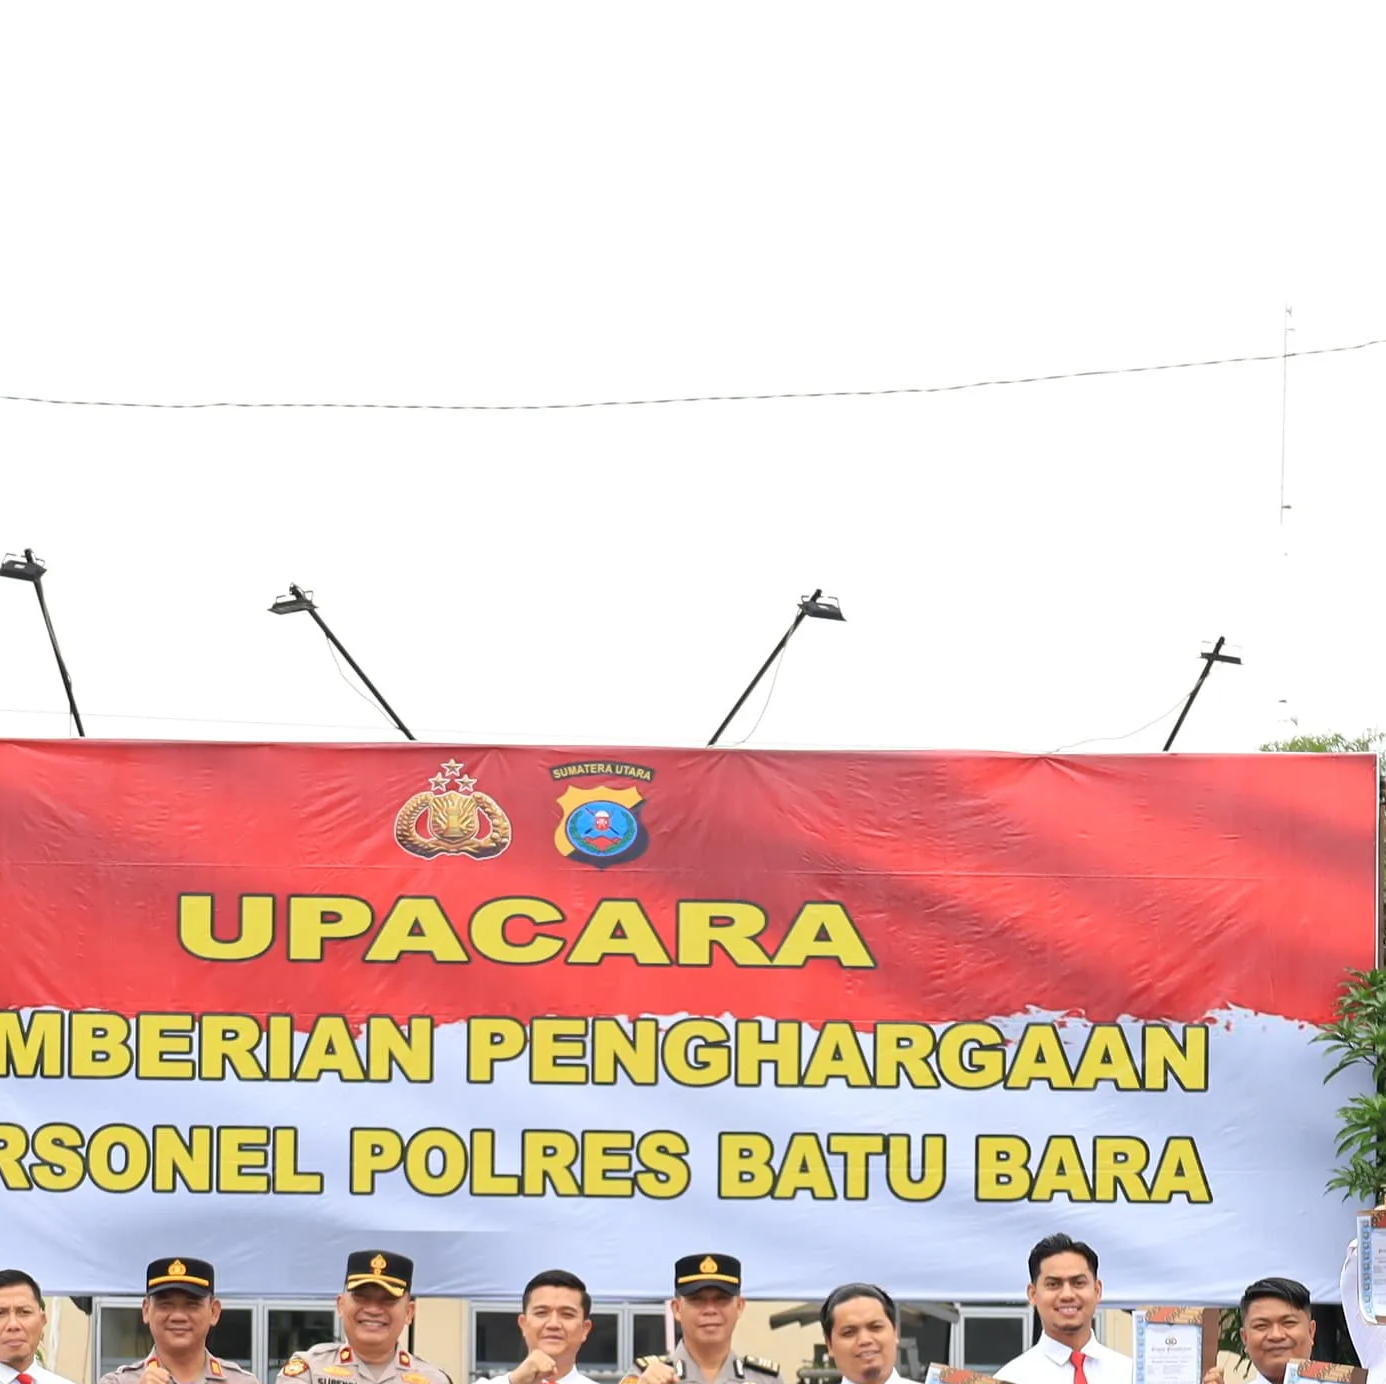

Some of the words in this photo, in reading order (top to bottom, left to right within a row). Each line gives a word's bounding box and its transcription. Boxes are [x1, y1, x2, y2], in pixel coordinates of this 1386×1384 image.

[553, 763, 613, 779] SUMATERA
[616, 765, 651, 780] UTARA
[176, 892, 878, 971] UPACARA
[466, 1014, 1210, 1093] PENGHARGAAN
[349, 1126, 692, 1201] POLRES
[717, 1130, 947, 1203] BATU
[974, 1133, 1213, 1205] BARA
